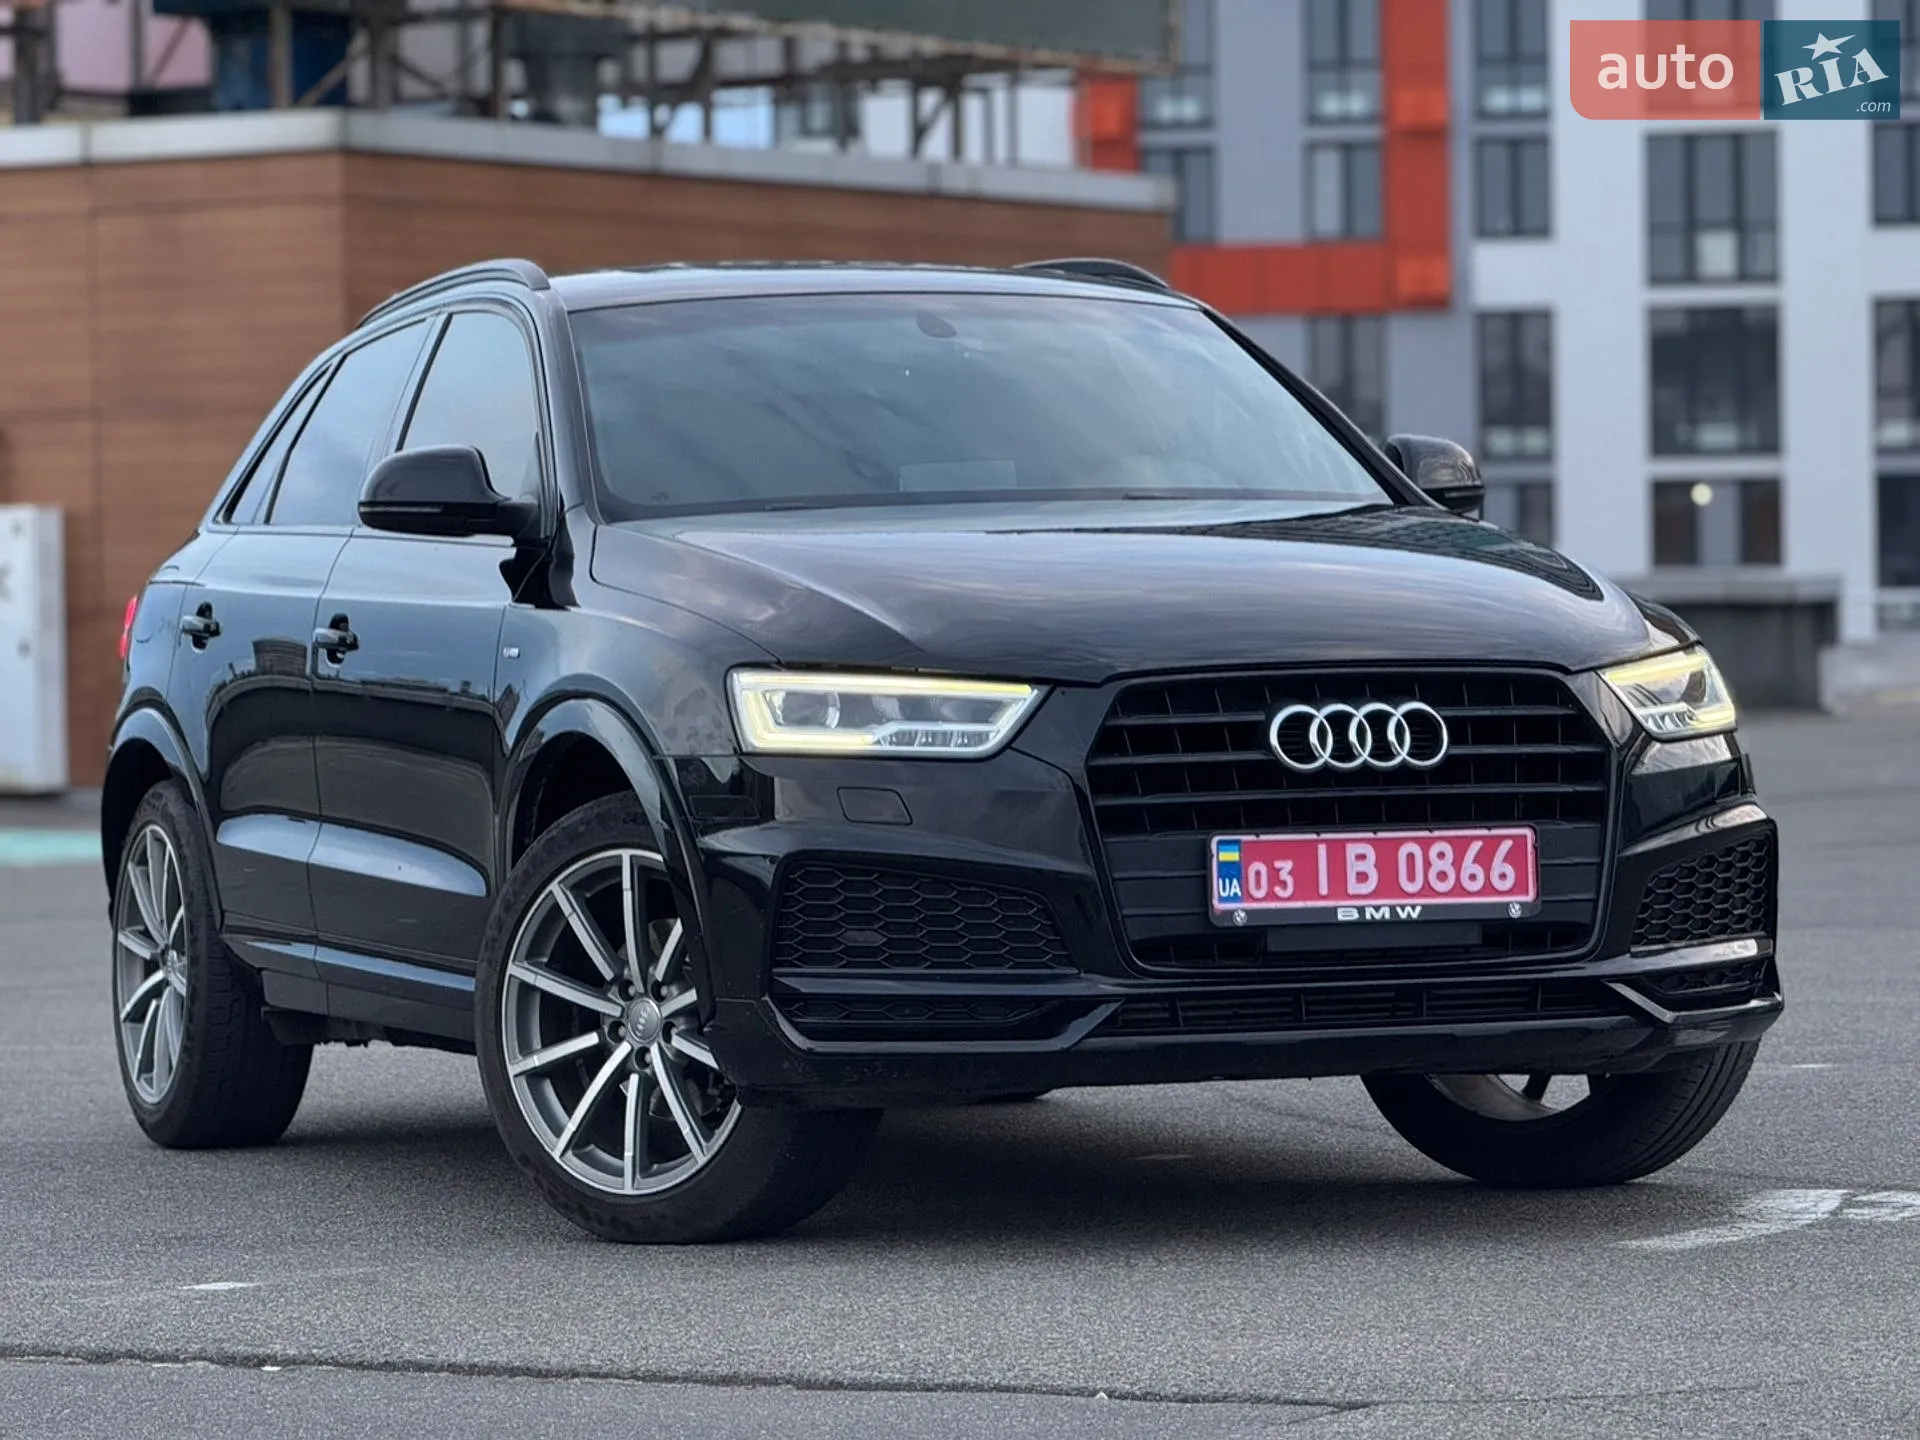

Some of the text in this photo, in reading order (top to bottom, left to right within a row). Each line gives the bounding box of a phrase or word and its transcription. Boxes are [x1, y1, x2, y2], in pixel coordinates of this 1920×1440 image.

[1247, 859, 1295, 900] 03
[1396, 839, 1517, 895] 0866
[1218, 878, 1242, 898] UA
[1336, 905, 1424, 921] BMW
